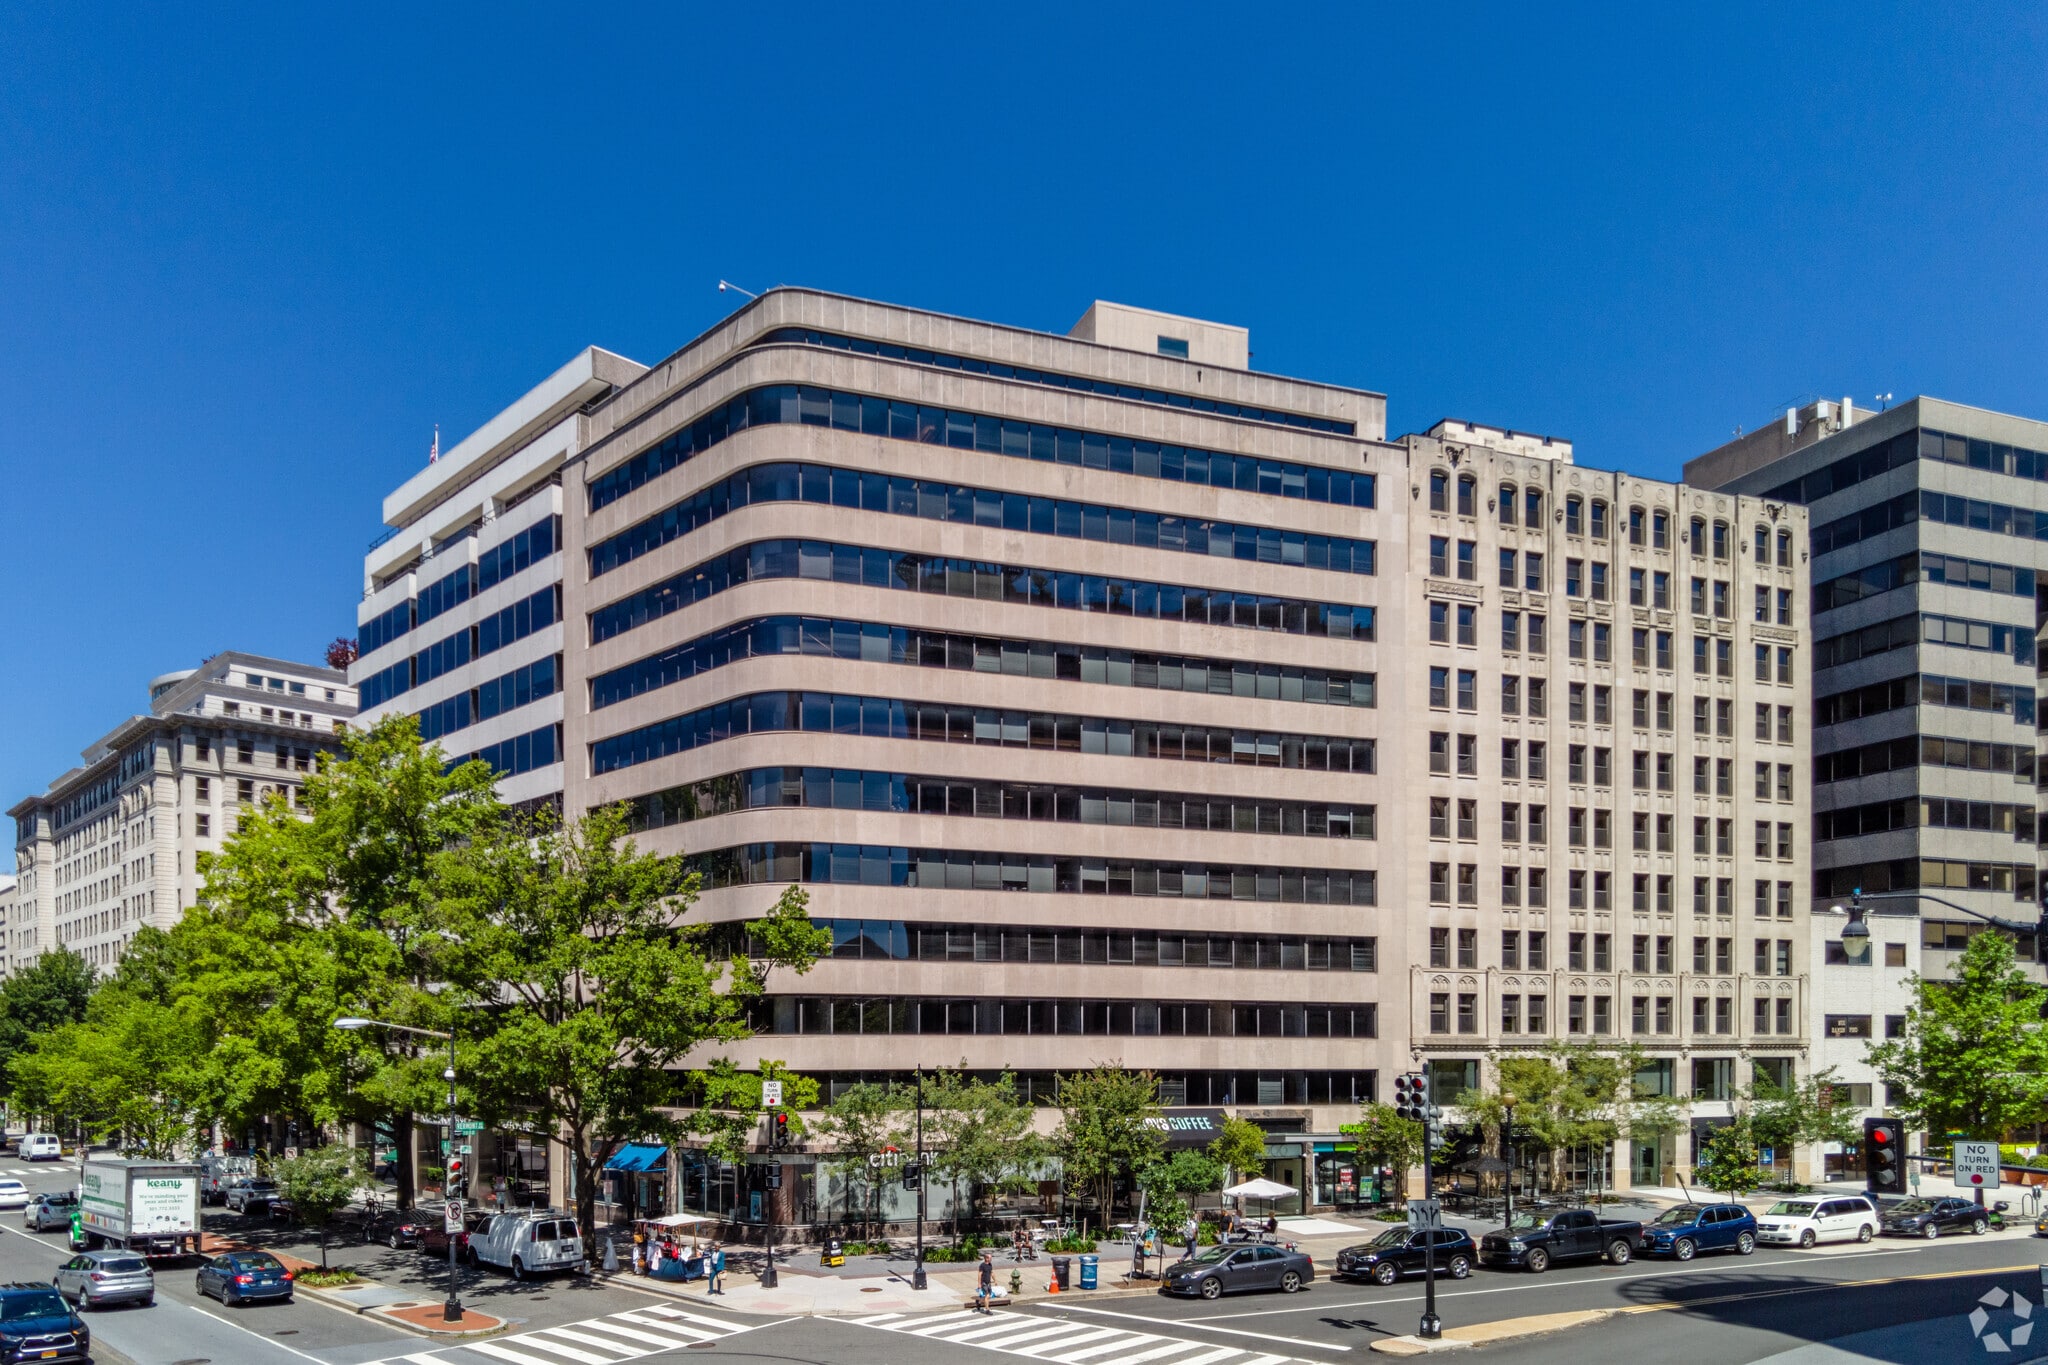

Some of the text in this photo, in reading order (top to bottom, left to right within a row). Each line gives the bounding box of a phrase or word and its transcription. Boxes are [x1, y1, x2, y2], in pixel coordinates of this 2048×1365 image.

[1168, 1117, 1213, 1130] COFFEE
[1967, 1145, 1986, 1154] NO
[869, 1149, 939, 1168] citink
[1964, 1156, 1989, 1164] TURN
[1976, 1165, 1995, 1174] RED
[147, 1177, 182, 1189] keany
